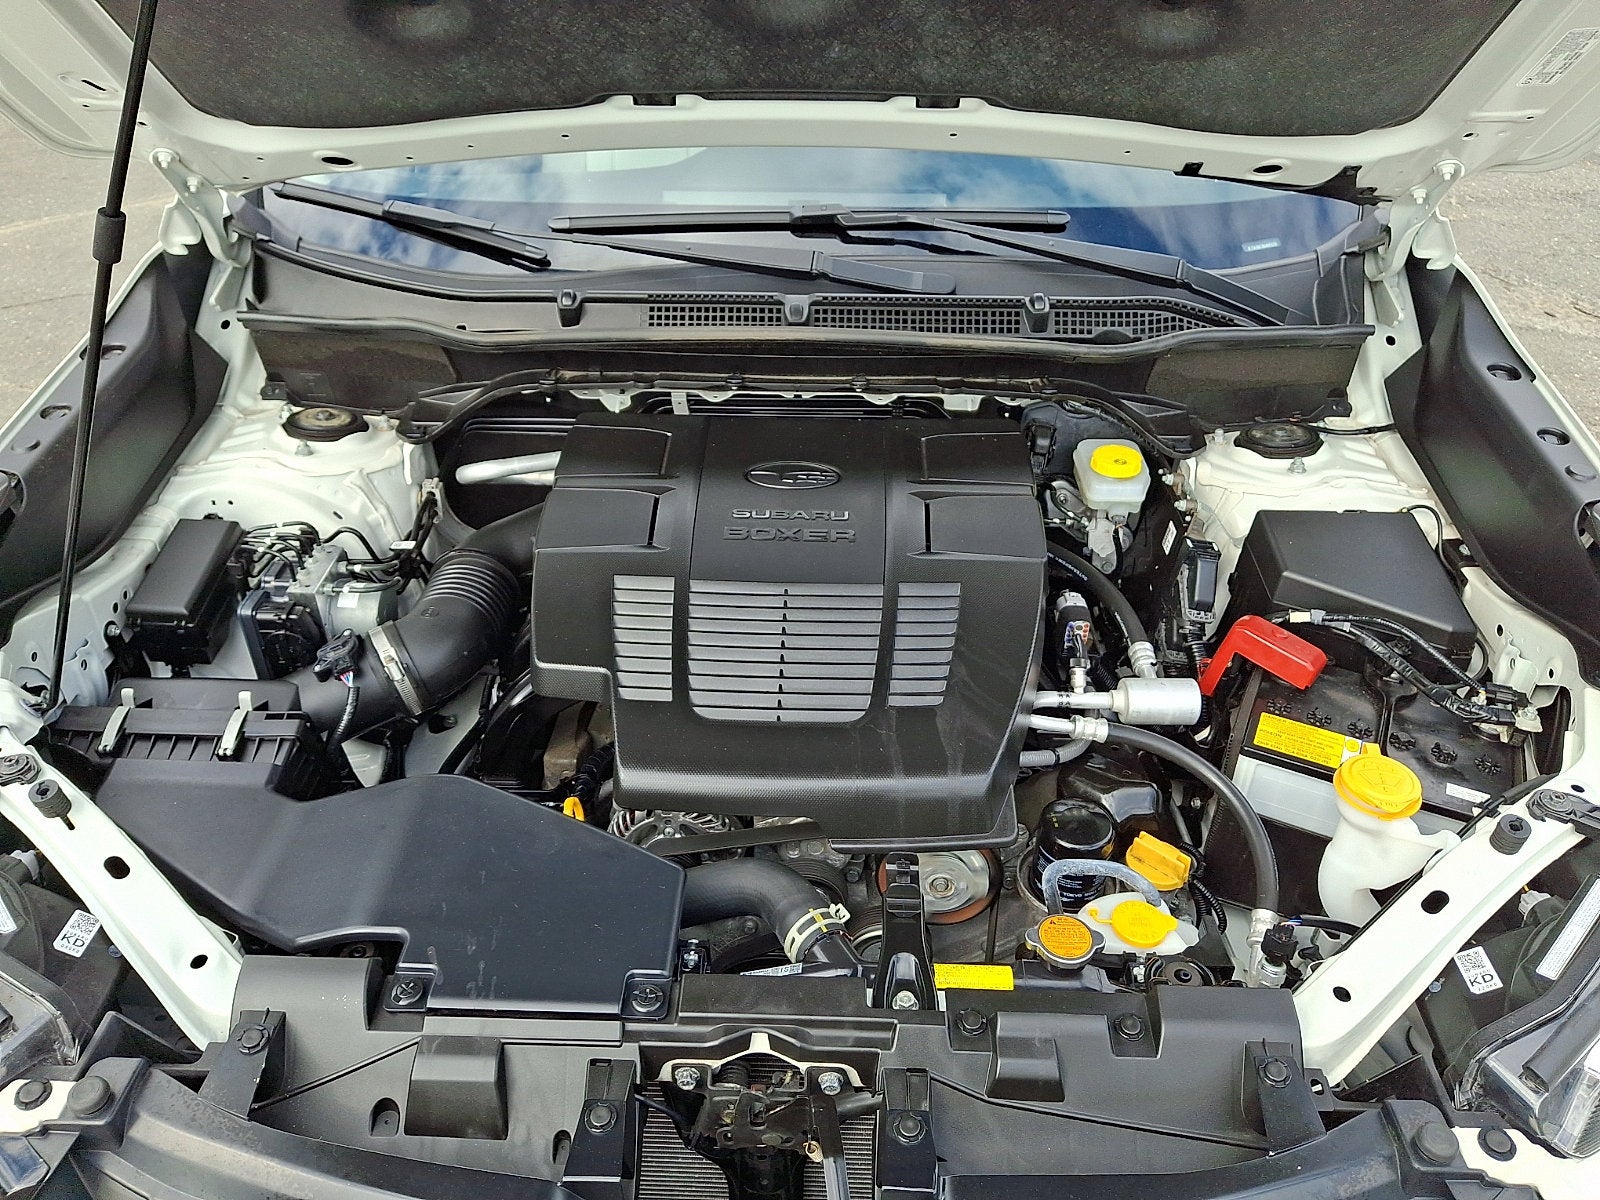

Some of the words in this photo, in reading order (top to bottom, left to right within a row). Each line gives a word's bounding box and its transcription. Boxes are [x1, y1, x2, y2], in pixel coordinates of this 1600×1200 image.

[732, 508, 850, 522] SUBARU
[723, 526, 857, 543] BOXER
[60, 933, 85, 948] KD
[1468, 973, 1494, 987] KD
